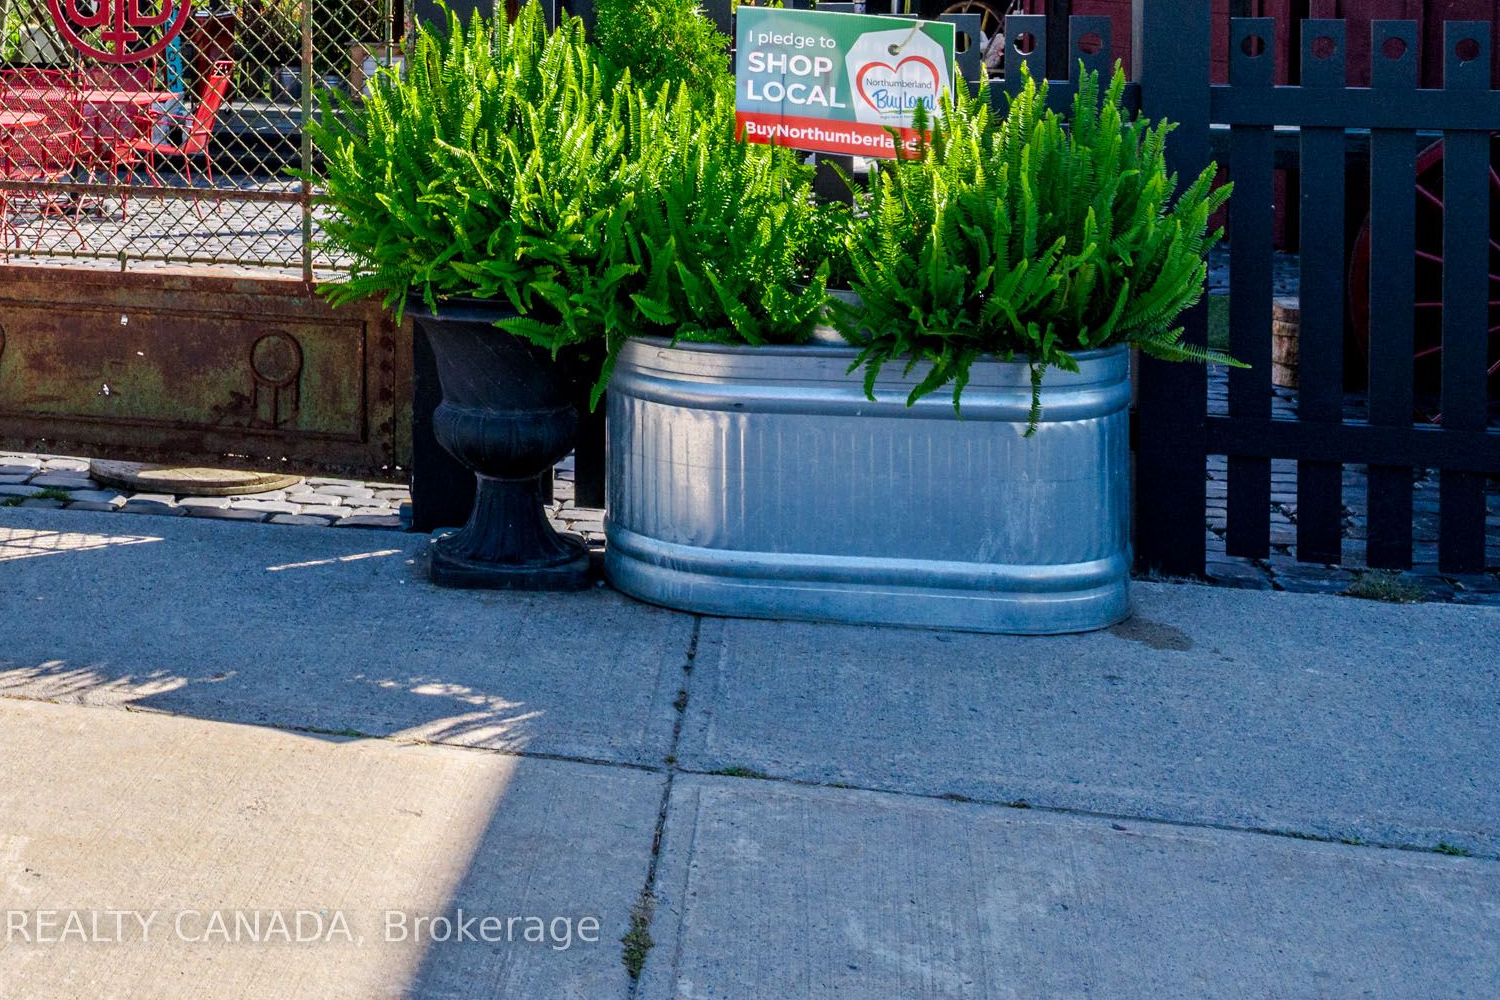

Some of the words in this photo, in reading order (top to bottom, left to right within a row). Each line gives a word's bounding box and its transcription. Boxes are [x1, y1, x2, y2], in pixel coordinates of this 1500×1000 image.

[749, 30, 753, 42] I
[758, 31, 815, 49] pledge
[820, 36, 836, 48] to
[748, 52, 833, 77] SHOP
[747, 80, 846, 108] LOCAL
[866, 78, 932, 89] Northumberland
[872, 89, 902, 114] Buy
[903, 92, 937, 111] Loal
